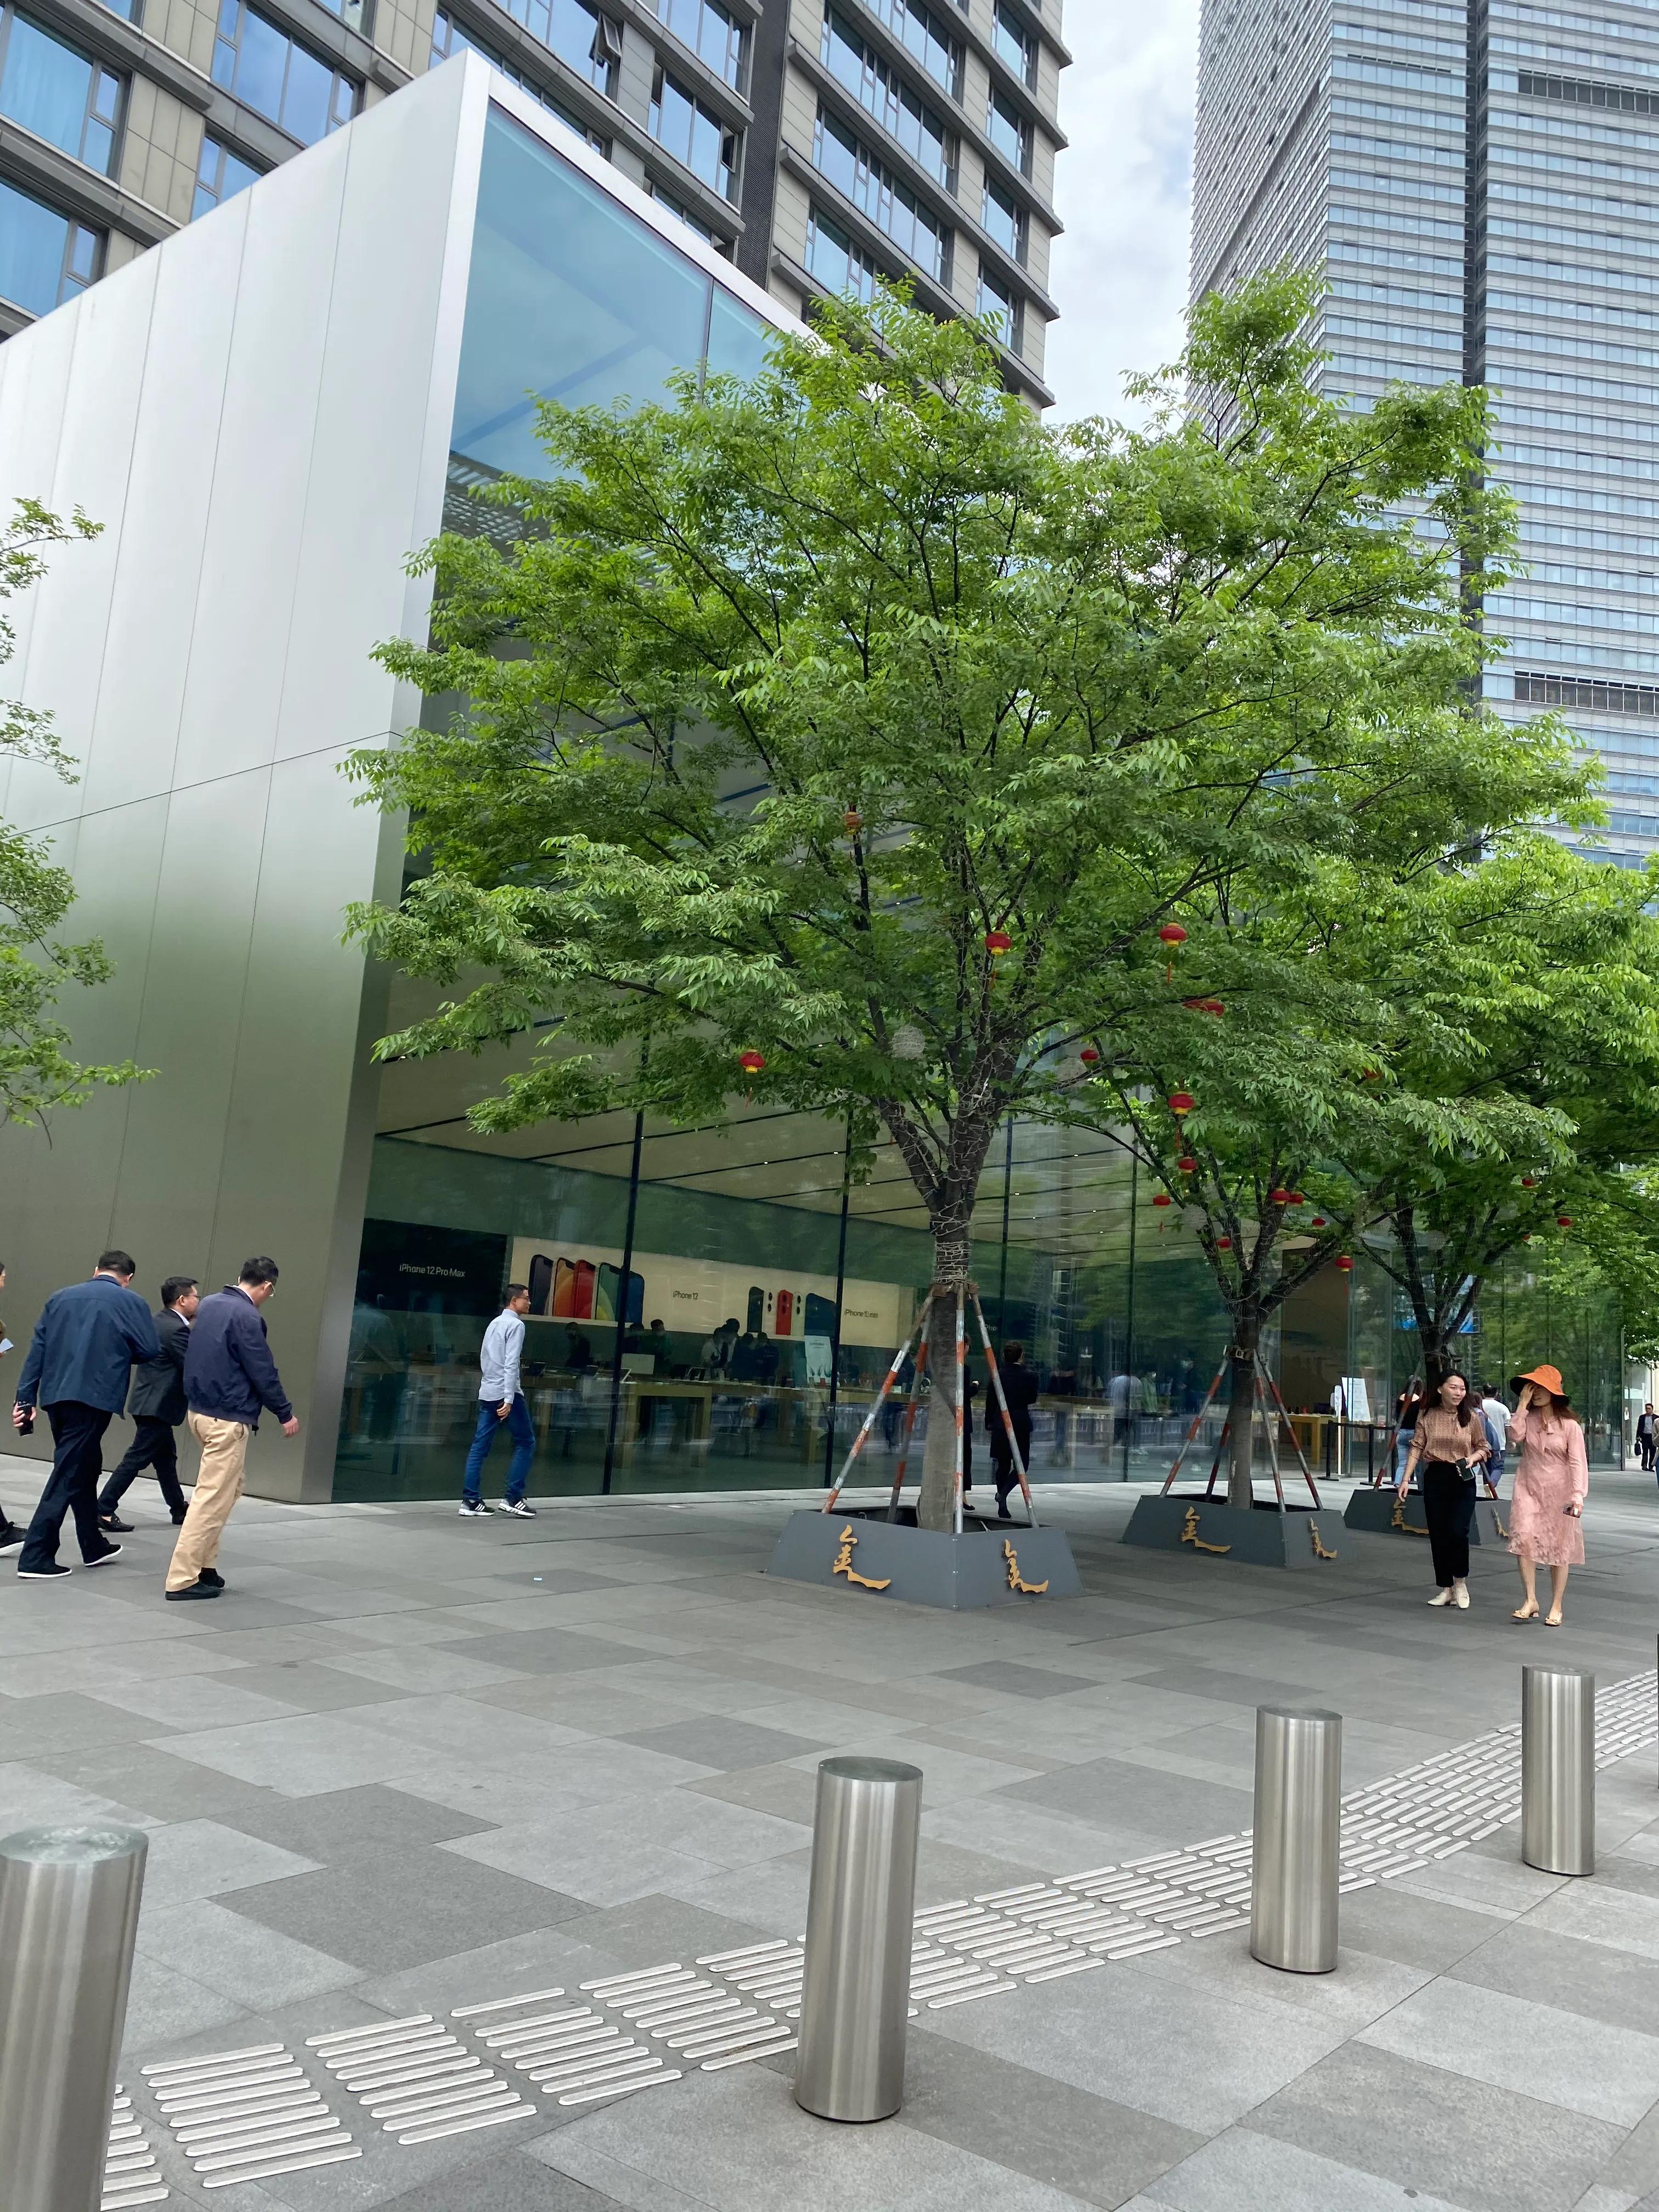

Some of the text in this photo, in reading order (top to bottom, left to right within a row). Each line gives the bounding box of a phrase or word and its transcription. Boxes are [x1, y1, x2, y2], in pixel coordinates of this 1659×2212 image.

[399, 1263, 466, 1277] iPhone 12 Pro Max
[673, 1290, 692, 1299] iPhone
